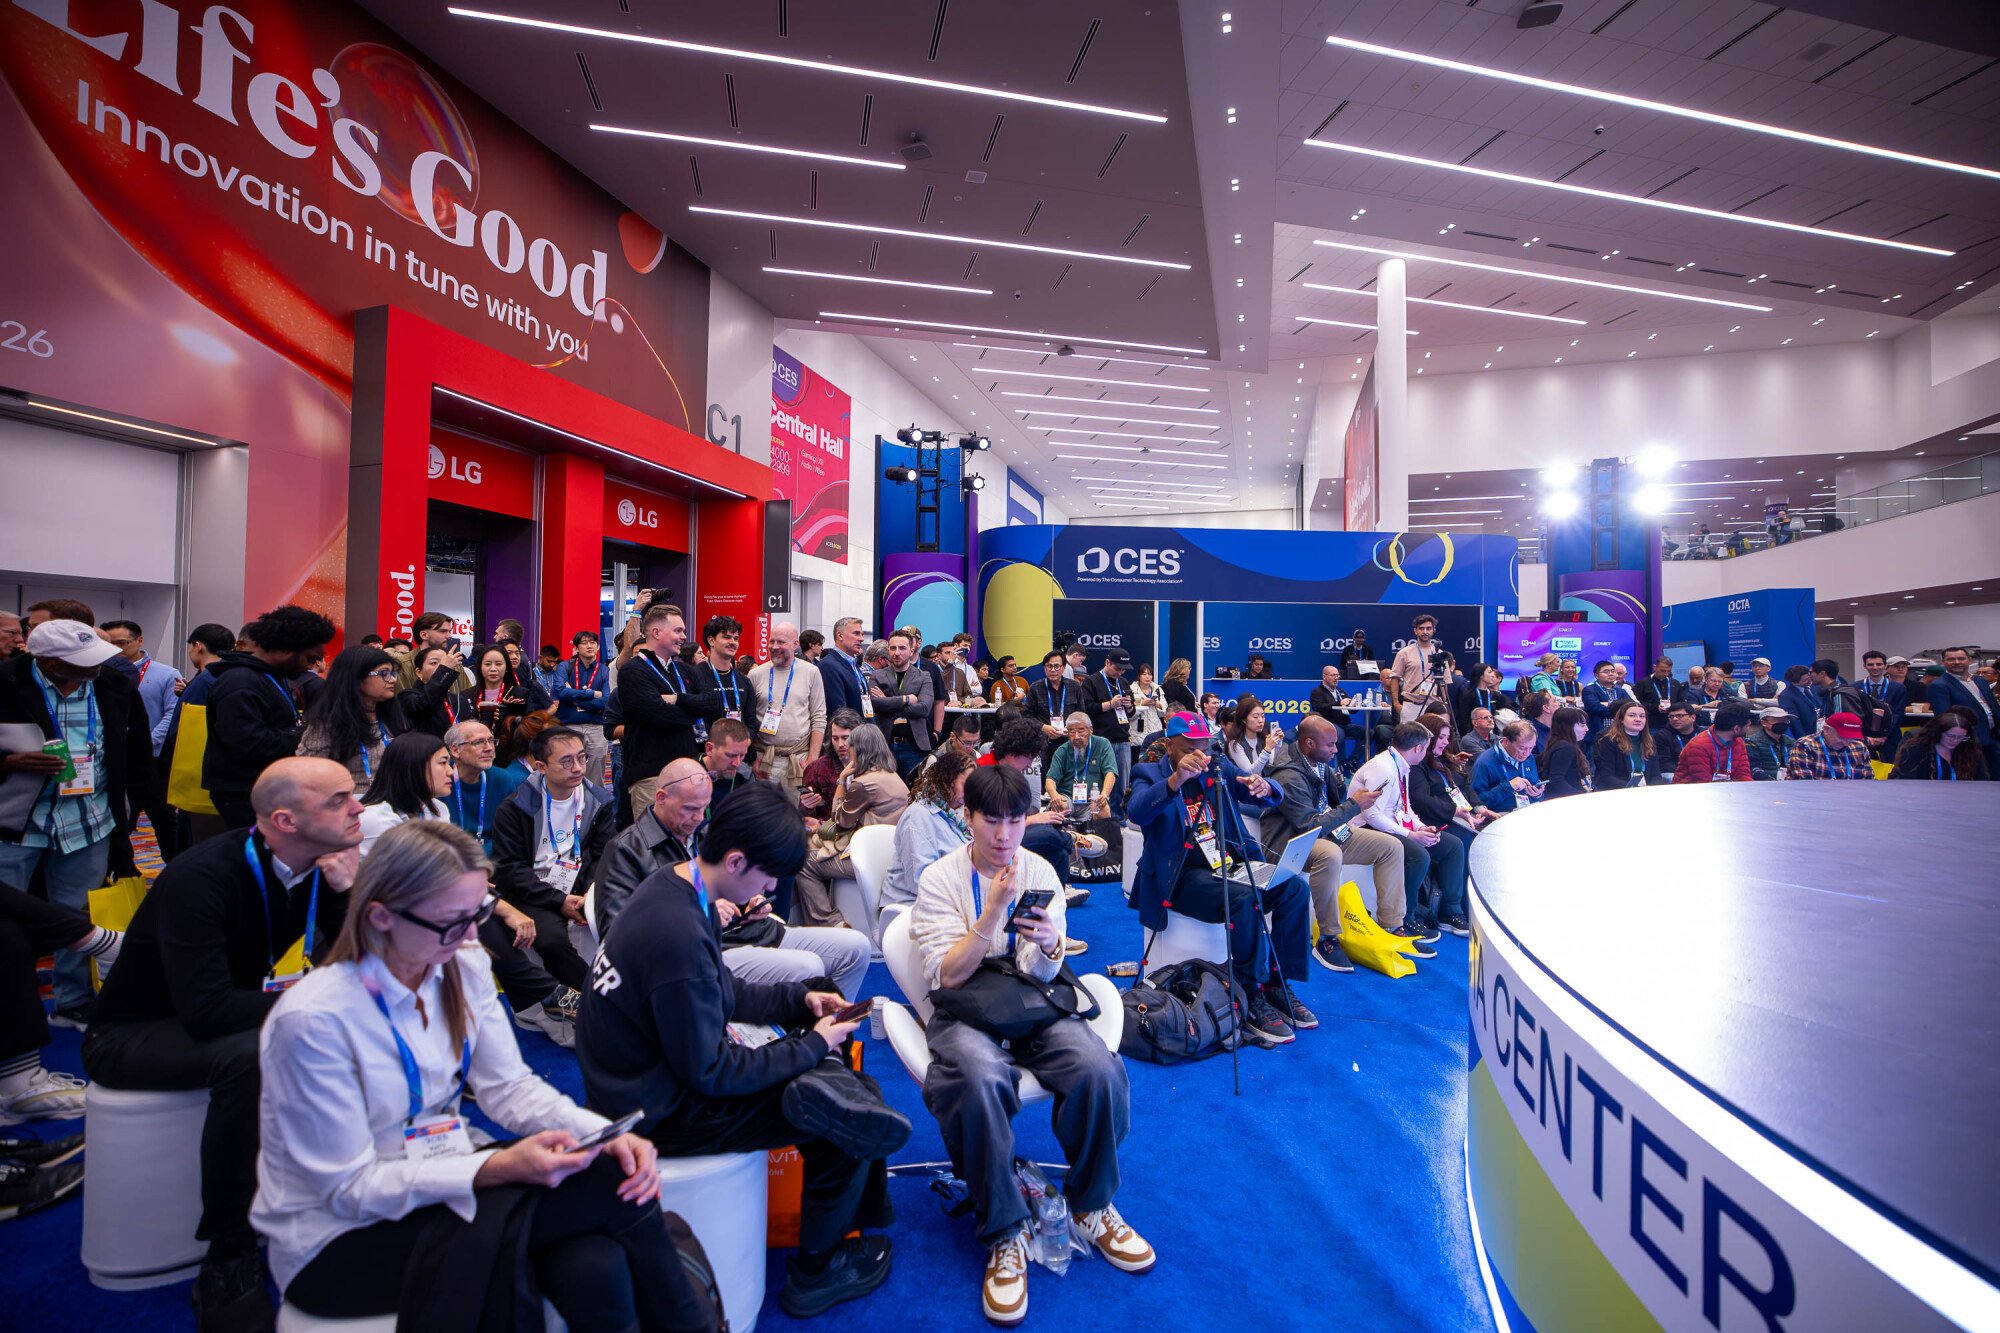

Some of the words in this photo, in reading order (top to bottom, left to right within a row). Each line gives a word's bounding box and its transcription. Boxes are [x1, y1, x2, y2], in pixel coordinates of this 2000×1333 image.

[11, 0, 381, 197] ife's
[410, 151, 624, 333] Good.
[78, 79, 354, 251] Innovation
[365, 227, 395, 272] in
[406, 250, 479, 308] tune
[485, 297, 539, 335] with
[546, 323, 589, 362] you
[778, 363, 798, 387] CES
[708, 404, 741, 454] C1
[820, 427, 844, 459] Hall
[451, 456, 482, 484] LG
[770, 457, 790, 476] 2999
[639, 507, 658, 528] LG
[768, 595, 783, 608] C1
[1736, 599, 1750, 610] CTA
[1093, 635, 1121, 647] CES
[1203, 637, 1221, 649] ES
[1264, 638, 1292, 650] CES
[1336, 638, 1354, 649] CE
[1070, 864, 1122, 878] EGWAY
[1469, 923, 1488, 1033] TA
[1493, 973, 1797, 1333] CENTER
